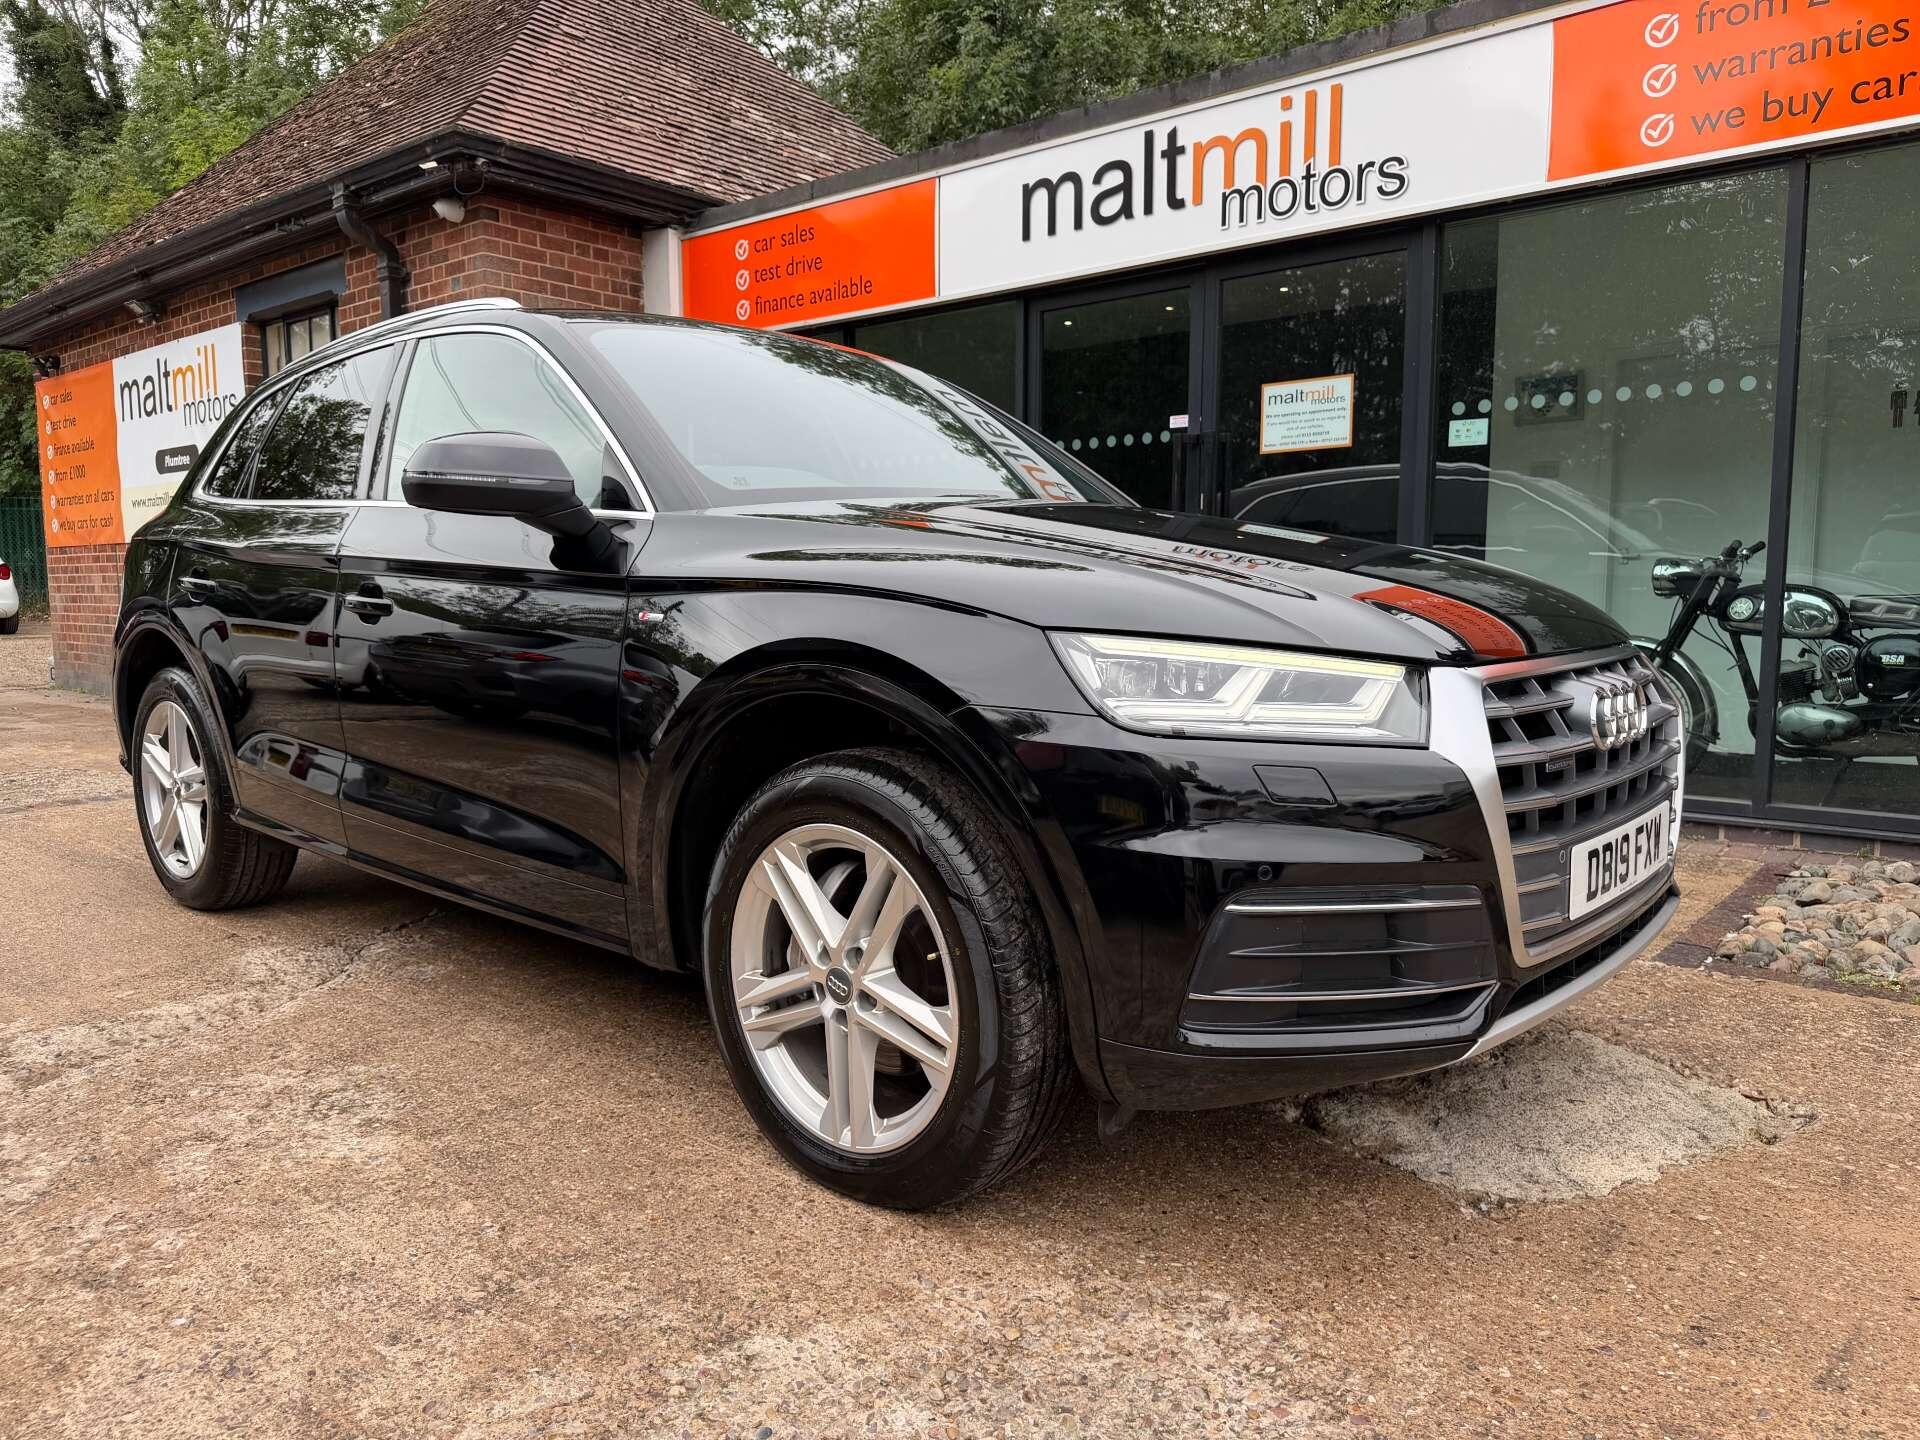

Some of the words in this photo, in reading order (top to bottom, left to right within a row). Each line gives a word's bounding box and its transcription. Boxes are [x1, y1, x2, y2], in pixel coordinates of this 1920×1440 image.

[1696, 0, 1788, 34] from
[1692, 18, 1910, 85] warranties
[1690, 105, 1746, 135] we
[1762, 87, 1834, 124] buy
[1850, 71, 1920, 104] car
[1021, 83, 1343, 242] maltmill
[1221, 155, 1408, 231] motors
[754, 236, 776, 253] car
[780, 224, 815, 247] sales
[754, 265, 781, 283] test
[786, 255, 823, 276] drive
[755, 293, 804, 316] finance
[809, 275, 873, 305] available
[60, 388, 73, 403] sales
[120, 343, 218, 421] maltmill
[1268, 384, 1335, 406] maltmill
[183, 391, 237, 426] motors
[1310, 395, 1346, 405] motors
[62, 415, 76, 429] drive
[71, 436, 95, 452] available
[55, 468, 68, 481] from
[164, 455, 190, 467] Plumtree
[86, 493, 93, 504] on
[101, 490, 114, 502] cars
[77, 519, 89, 529] cars
[90, 515, 98, 528] for
[100, 513, 114, 527] cash
[1586, 832, 1630, 903] DB19
[1633, 812, 1662, 876] FXW
